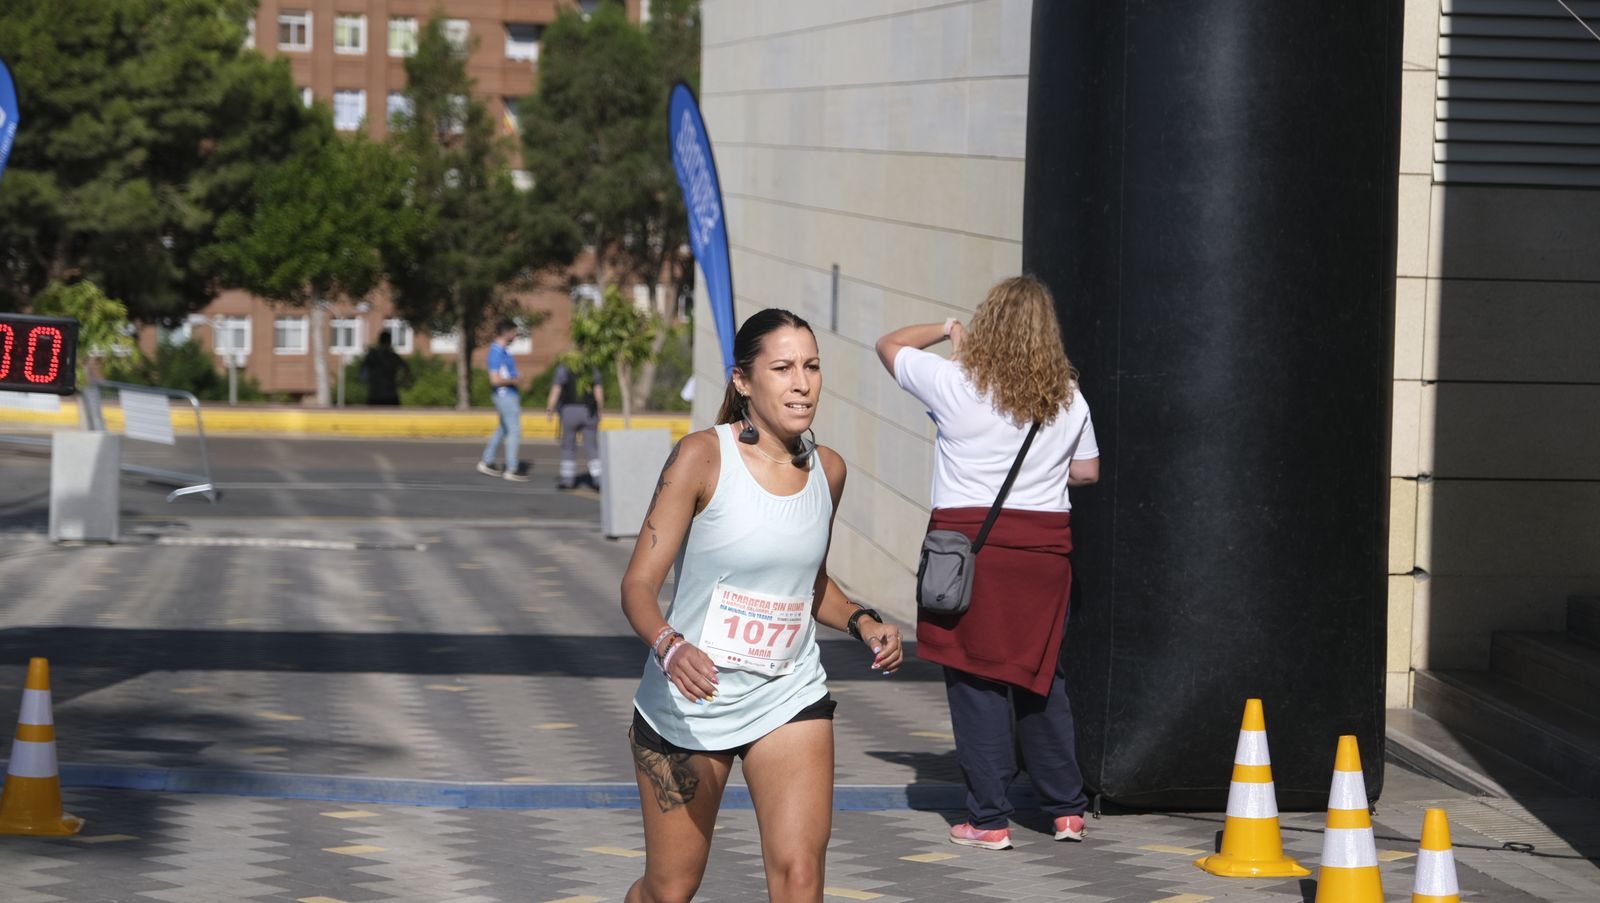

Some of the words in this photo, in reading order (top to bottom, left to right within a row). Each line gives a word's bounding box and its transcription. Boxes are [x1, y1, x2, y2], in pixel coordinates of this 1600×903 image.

[772, 601, 786, 611] SIN
[723, 615, 802, 649] 1077
[747, 647, 772, 658] MARÍA
